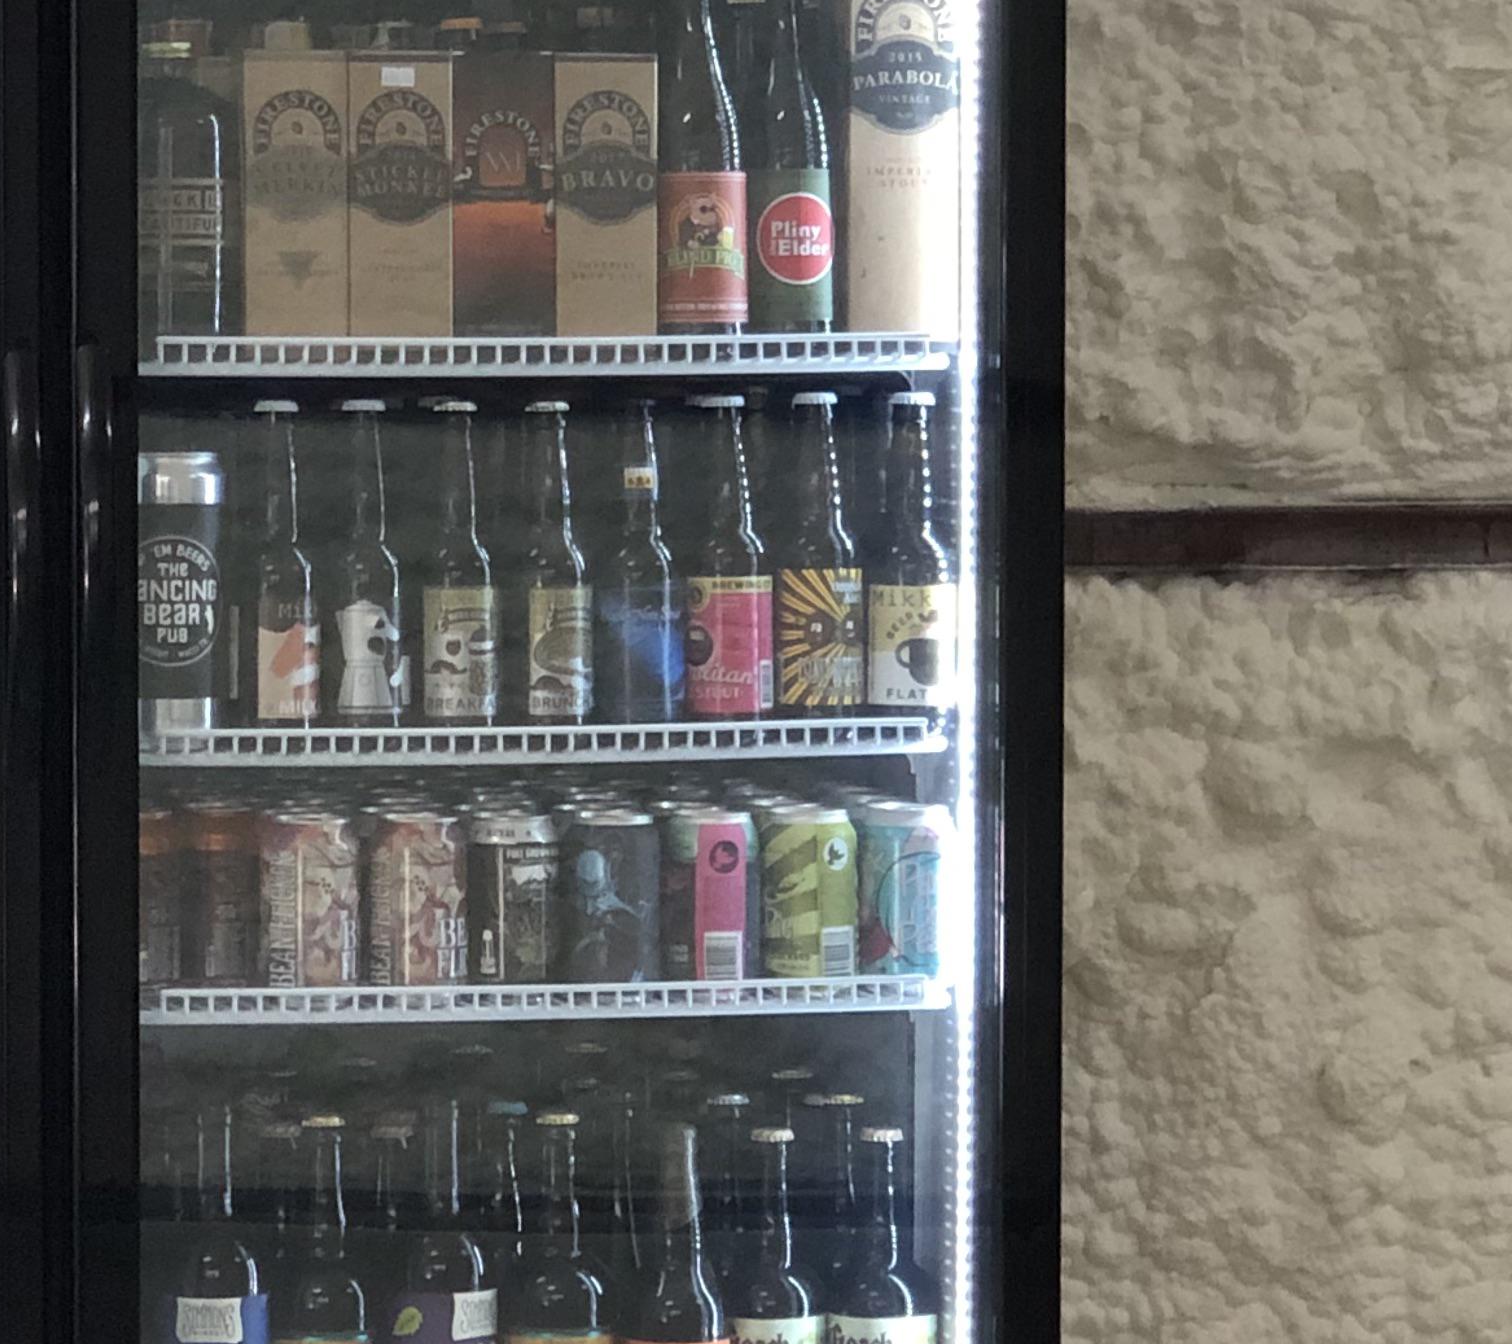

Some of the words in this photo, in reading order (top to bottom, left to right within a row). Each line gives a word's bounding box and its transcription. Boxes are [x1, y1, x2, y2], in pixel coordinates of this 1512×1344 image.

[852, 69, 959, 96] PARABOLA
[254, 91, 342, 146] FIRESTONE
[358, 91, 446, 146] FIRESTONE
[565, 92, 650, 146] FIRESTONE
[465, 110, 540, 157] FIRESTONE
[562, 169, 655, 193] BRAVO
[771, 220, 822, 243] Pliny
[778, 238, 829, 258] Elder
[157, 562, 189, 577] THE
[157, 627, 189, 644] PUB
[427, 696, 491, 709] BREAKF
[697, 685, 740, 699] STOUT
[887, 688, 928, 700] FLAT
